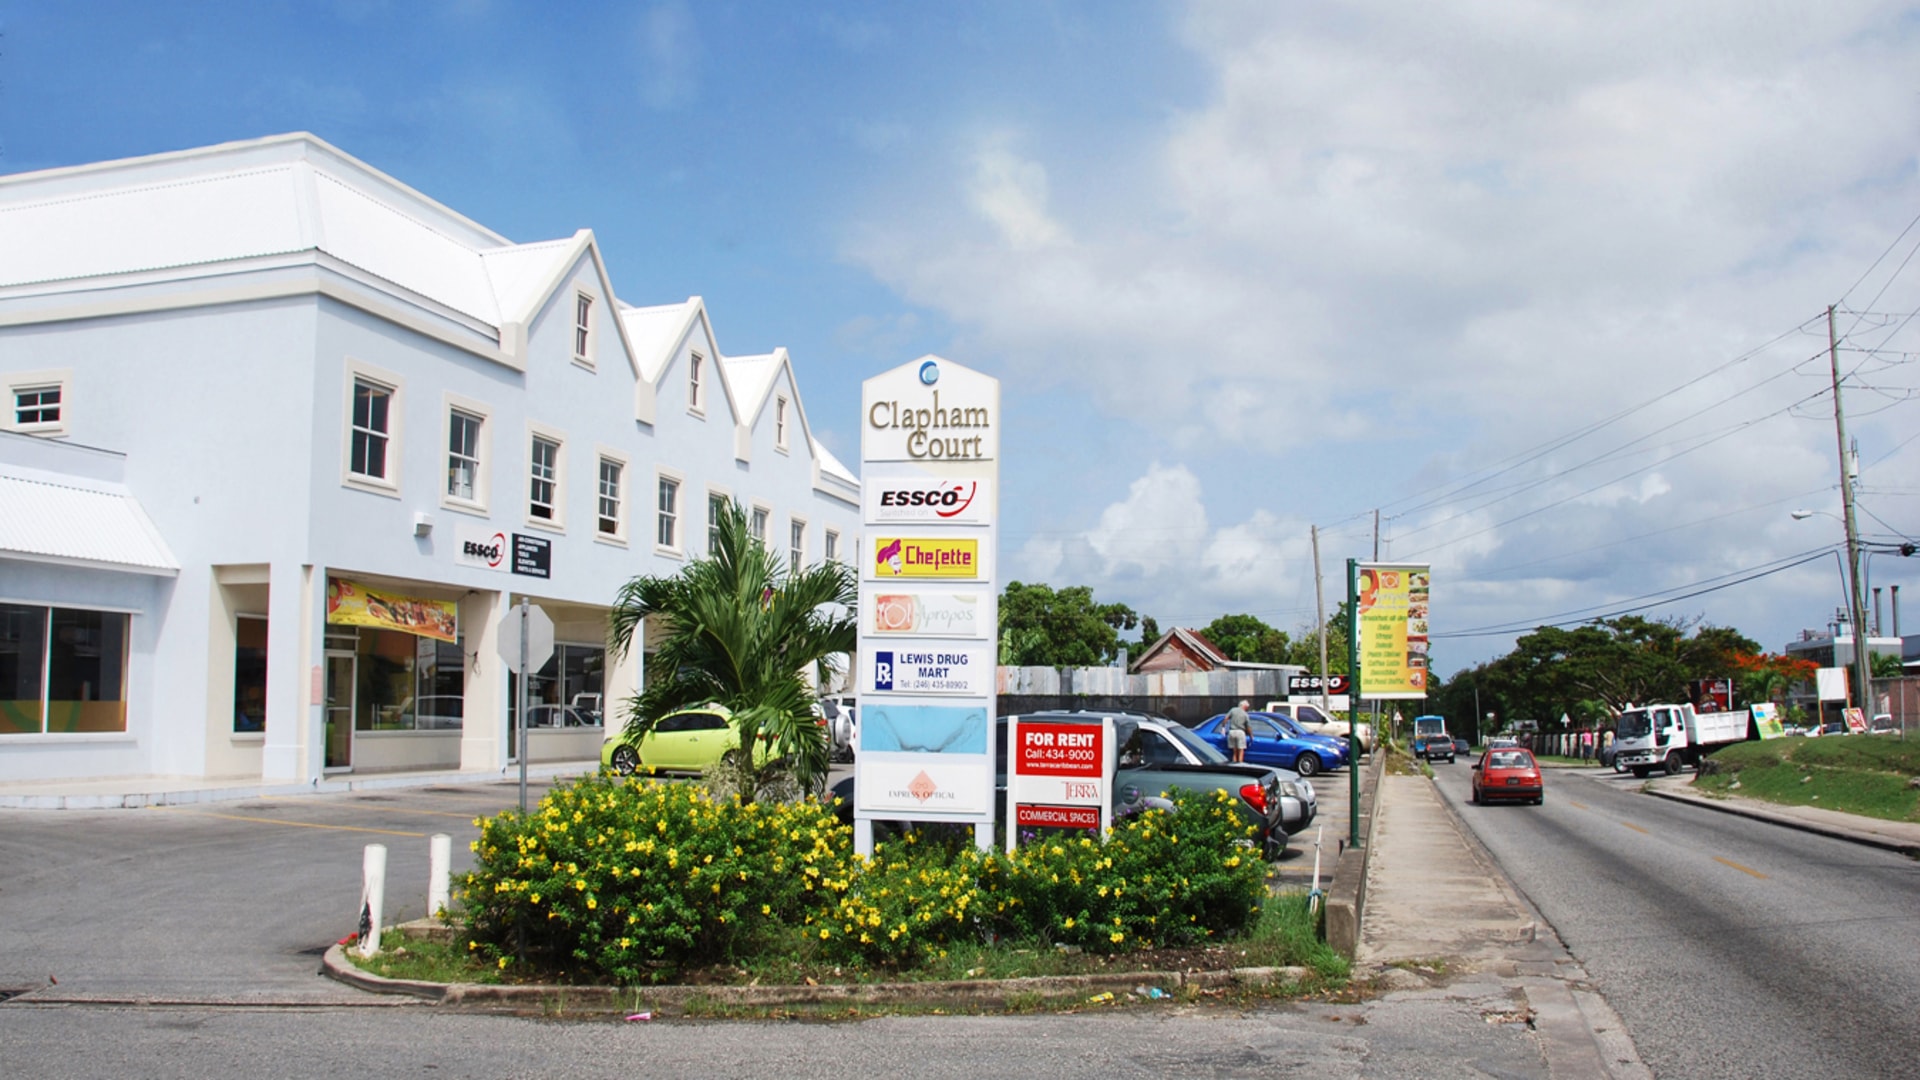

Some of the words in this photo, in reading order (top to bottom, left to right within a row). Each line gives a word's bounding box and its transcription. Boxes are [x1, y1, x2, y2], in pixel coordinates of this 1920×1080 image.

[869, 390, 989, 445] Clapham
[907, 431, 982, 458] Court
[881, 490, 959, 506] ESSCO
[464, 541, 499, 559] ESSCO
[906, 546, 971, 570] Chefette
[900, 653, 934, 664] LEWIS
[937, 653, 968, 665] DRUG
[918, 667, 949, 678] MART
[1026, 732, 1054, 746] FOR
[1058, 733, 1095, 747] RENT
[1025, 748, 1044, 759] Call:
[1045, 749, 1094, 760] 434-9000
[1061, 781, 1099, 800] TERRA
[1020, 810, 1068, 822] COMMERCIAL
[1069, 812, 1095, 823] SPACES
